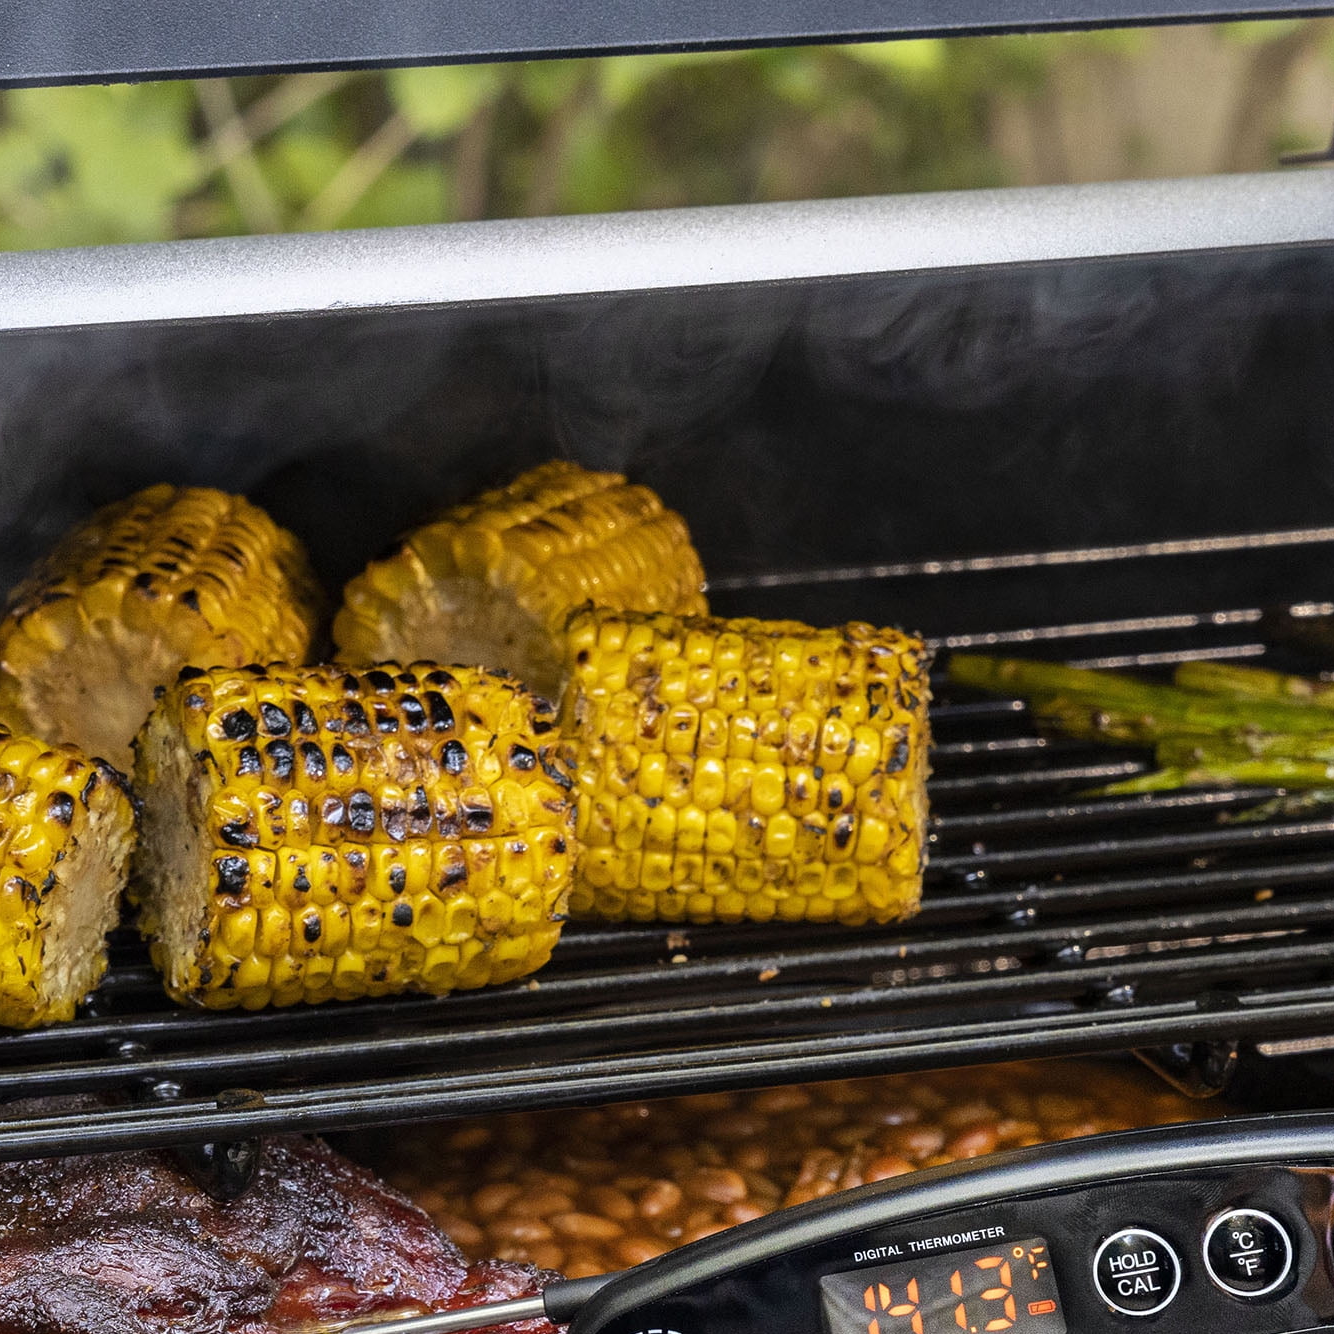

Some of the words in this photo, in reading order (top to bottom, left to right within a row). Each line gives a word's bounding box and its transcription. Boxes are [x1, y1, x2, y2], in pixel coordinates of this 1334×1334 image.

[854, 1244, 903, 1262] DIGITAL
[907, 1226, 1006, 1252] THERMOMETER
[1231, 1231, 1255, 1250] °C
[1108, 1250, 1157, 1272] HOLD
[1236, 1257, 1260, 1276] °F
[1117, 1275, 1162, 1297] CAL
